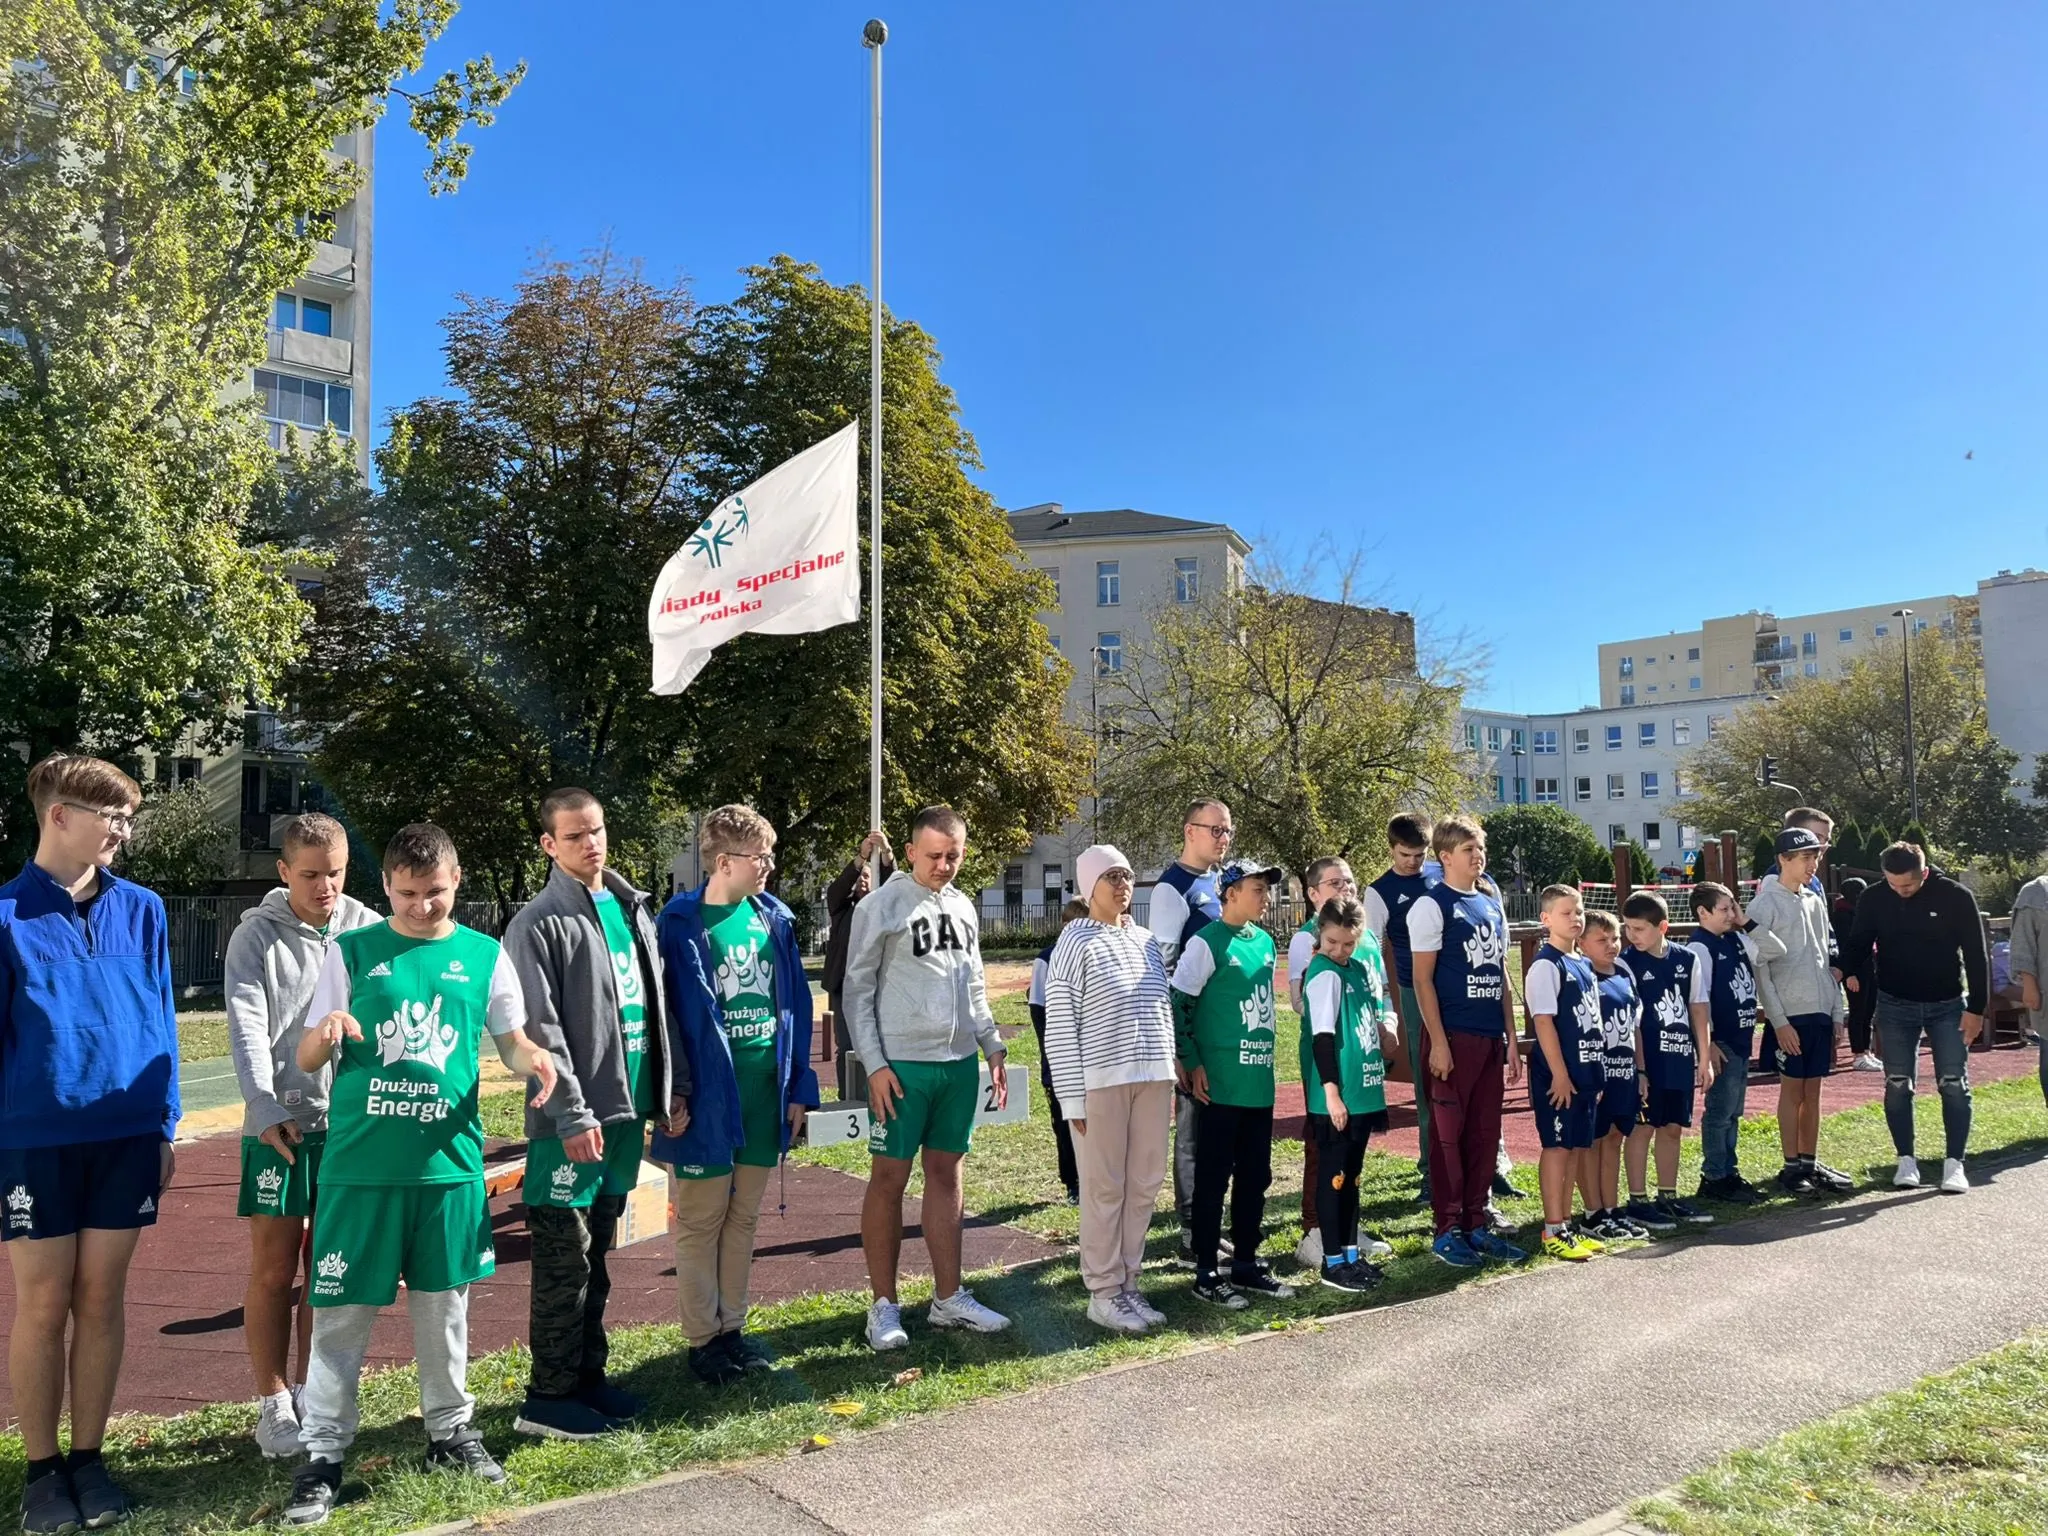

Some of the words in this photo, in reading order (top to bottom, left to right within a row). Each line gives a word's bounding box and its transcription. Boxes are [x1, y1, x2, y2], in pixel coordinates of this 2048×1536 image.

[737, 550, 845, 592] Specjalne
[699, 599, 762, 624] Polska
[912, 913, 976, 957] GAP
[621, 1020, 647, 1034] użyna
[1660, 1030, 1689, 1041] Drużyna
[1660, 1041, 1692, 1056] Energii
[369, 1078, 439, 1097] Drużyna
[984, 1085, 998, 1112] 2
[366, 1095, 450, 1122] Energii
[847, 1114, 860, 1138] 3
[314, 1286, 344, 1296] Energii
